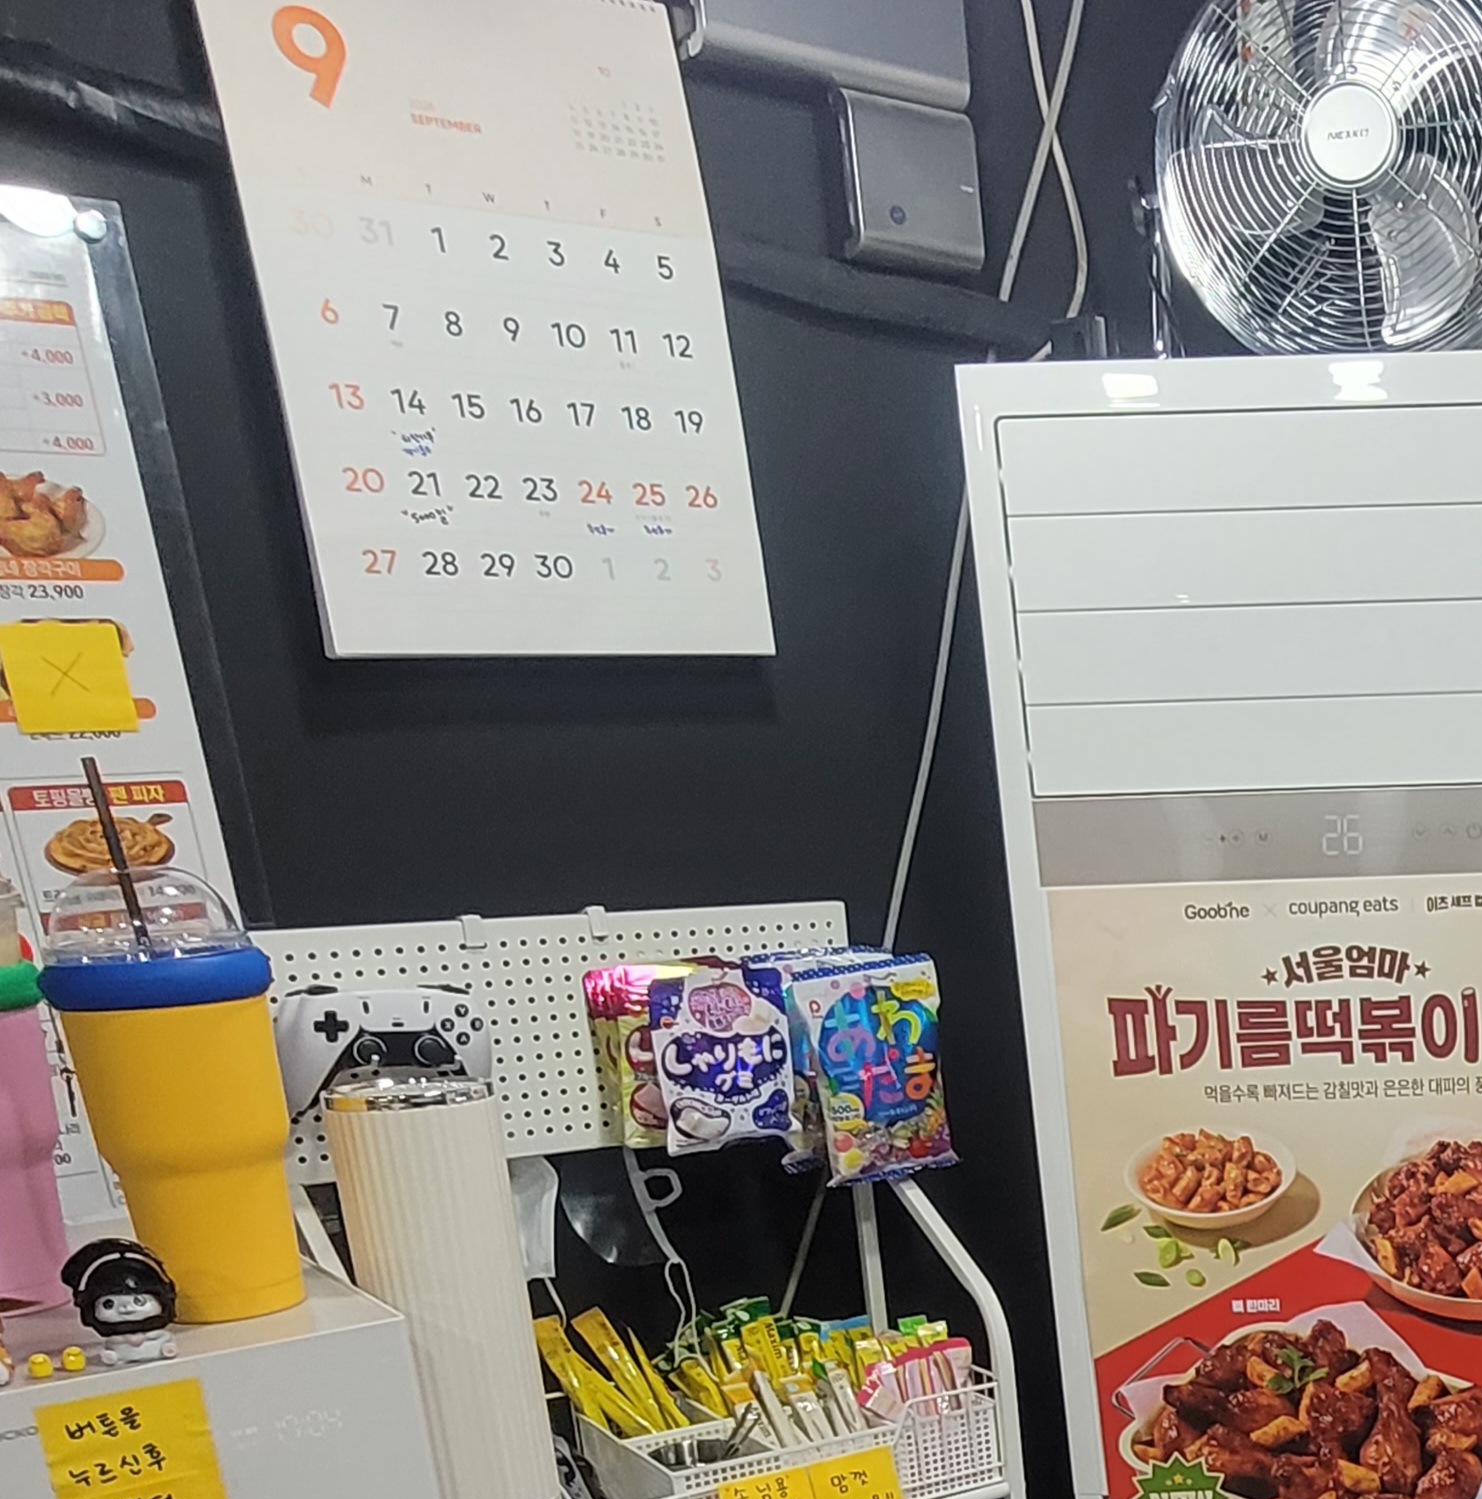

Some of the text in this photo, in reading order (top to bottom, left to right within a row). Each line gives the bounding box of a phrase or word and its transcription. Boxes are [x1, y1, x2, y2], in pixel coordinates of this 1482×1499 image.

[271, 5, 347, 108] 9
[409, 112, 483, 135] SEPTEMBER
[360, 174, 373, 187] M
[481, 191, 496, 204] W
[359, 217, 394, 247] 31
[430, 226, 446, 254] 1
[489, 234, 509, 261] 2
[546, 240, 565, 267] 3
[604, 249, 621, 274] 4
[657, 255, 674, 280] 5
[320, 298, 693, 359] 6 7 8 9 10 11 12
[328, 383, 703, 434] 13 14 15 16 17 18 19
[341, 466, 718, 509] 20 21 22 23 24 25 26
[361, 549, 722, 583] 27 28 29 30 1 2 3
[28, 584, 85, 600] 23,900
[133, 783, 166, 804] 피자
[1321, 814, 1364, 857] 26
[1184, 896, 1400, 920] Goobne coupang eats
[1281, 945, 1412, 988] 서울엄마
[1107, 985, 1481, 1078] 파기름떡볶이
[1204, 1084, 1260, 1104] 먹을수록
[1322, 1080, 1378, 1100] 감칠맛과
[1383, 1078, 1425, 1098] 은은한
[1428, 1076, 1471, 1097] 대파의
[63, 1405, 142, 1441] 버튼을
